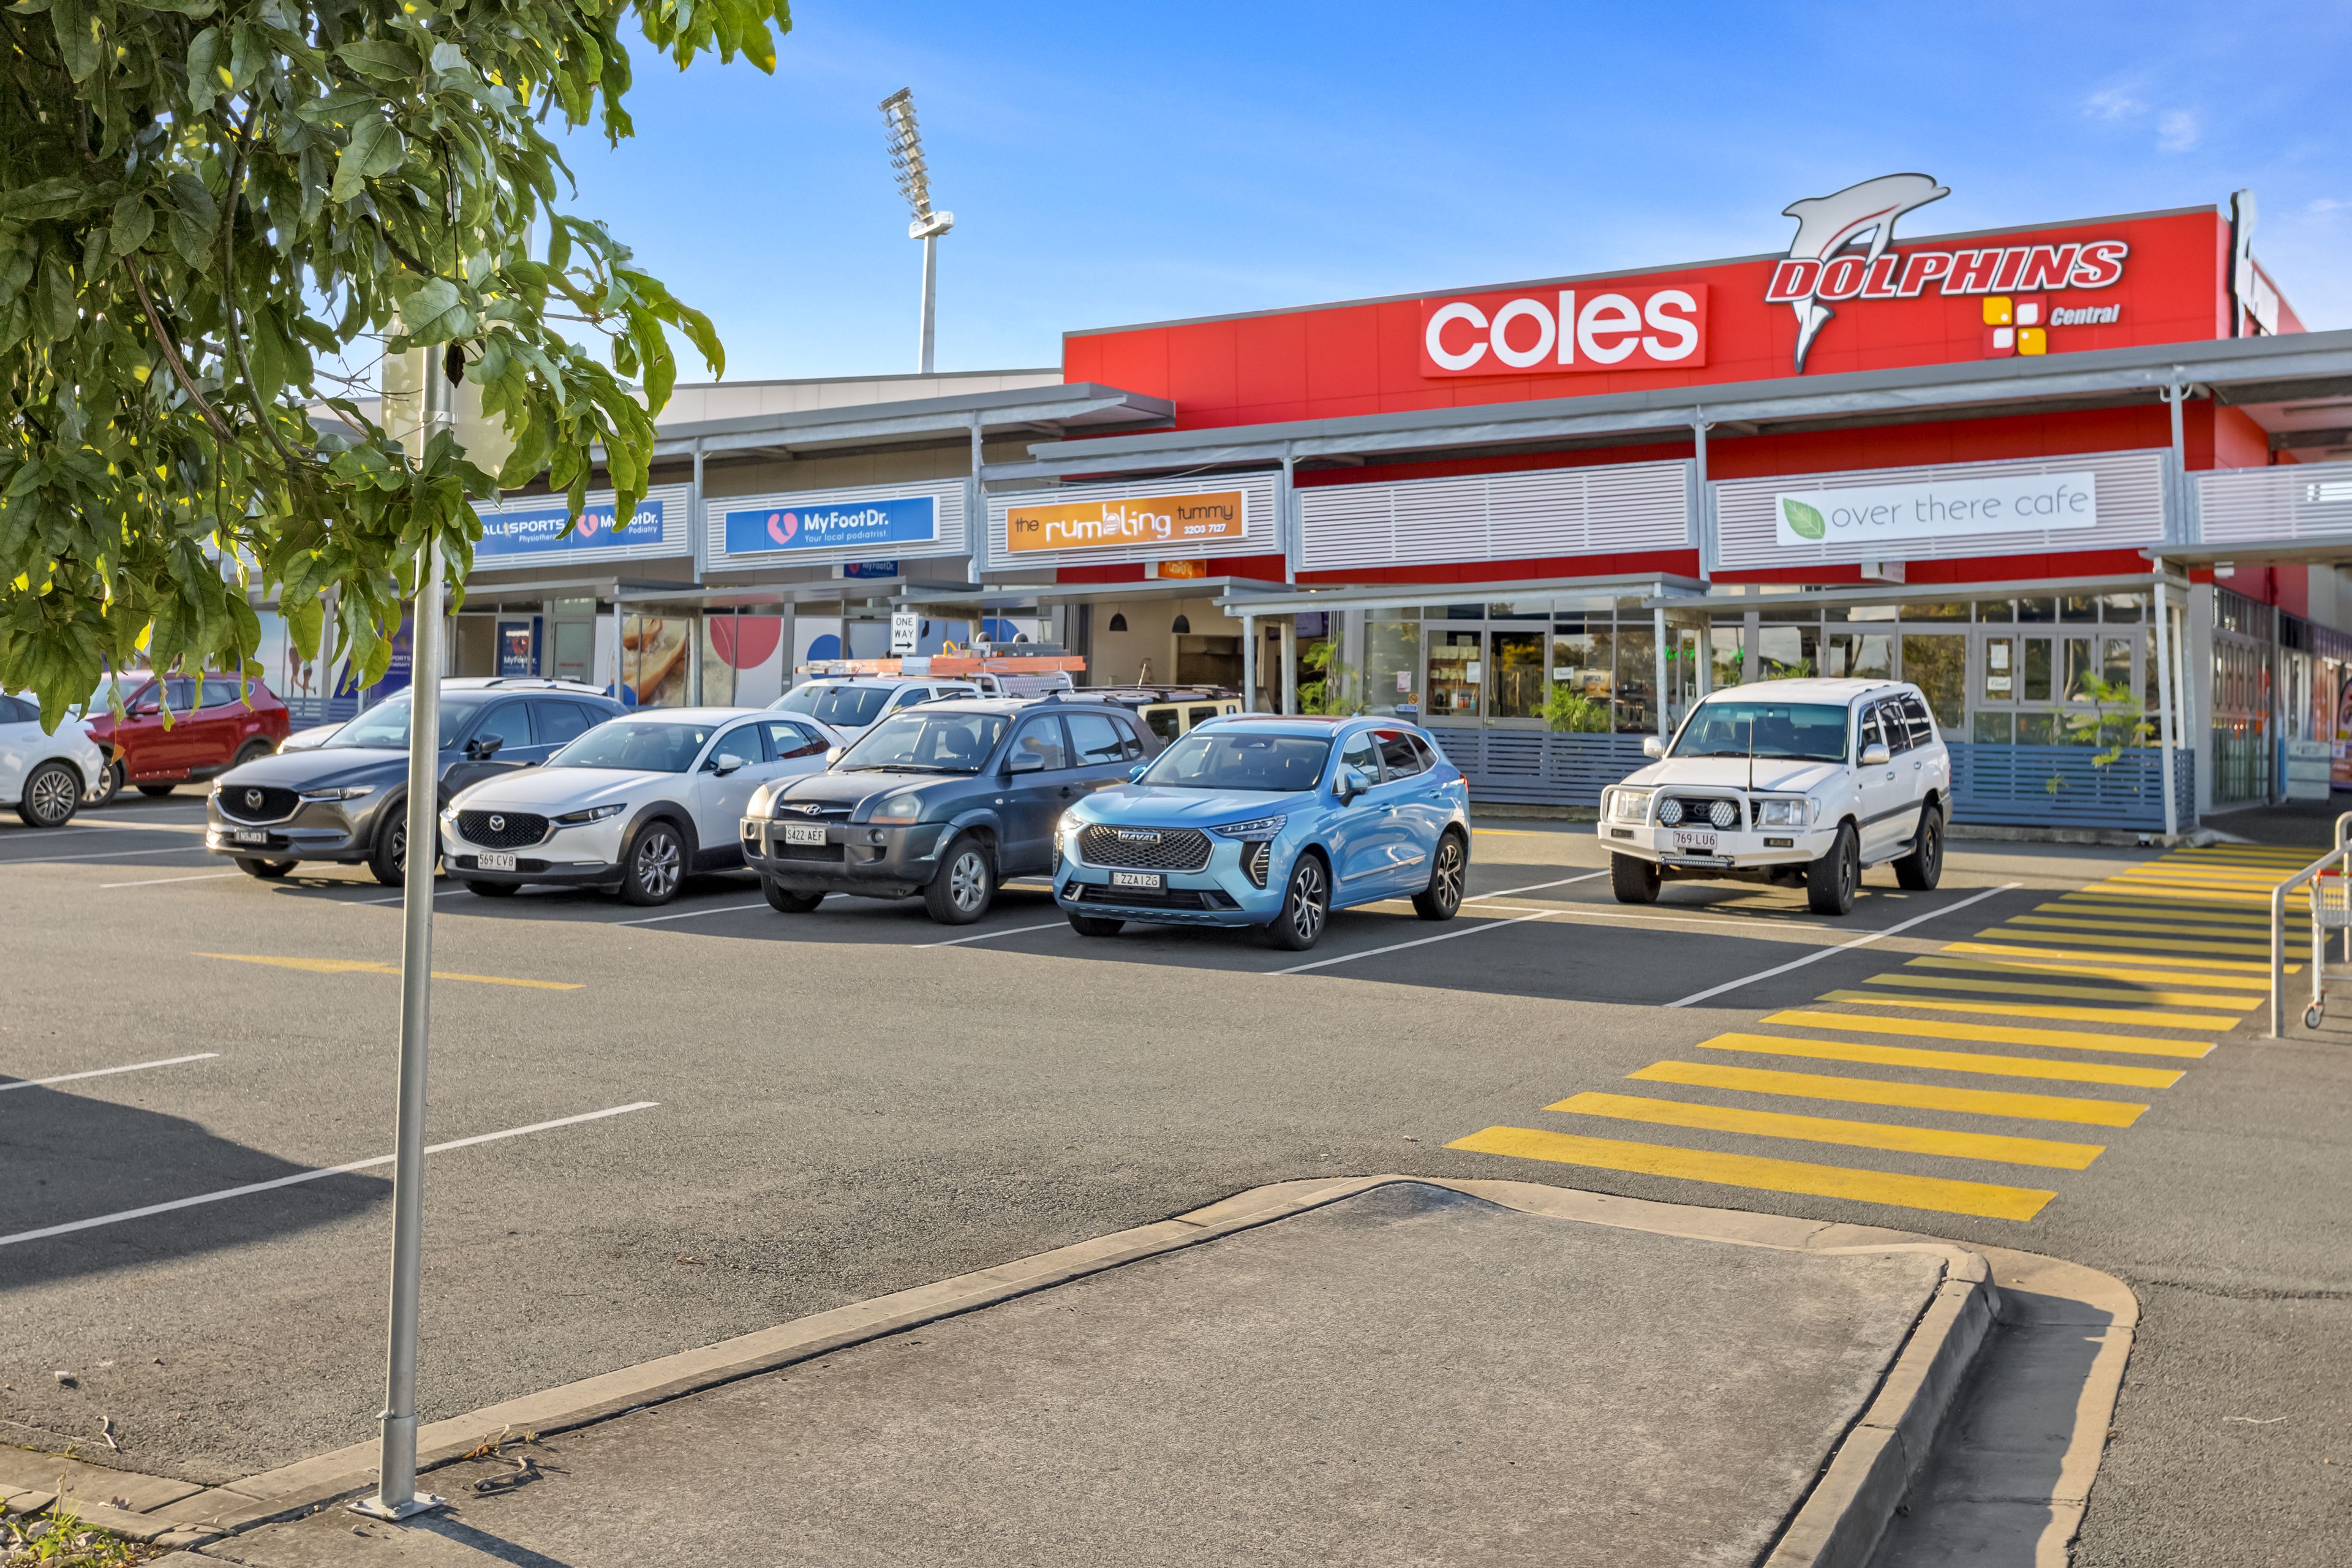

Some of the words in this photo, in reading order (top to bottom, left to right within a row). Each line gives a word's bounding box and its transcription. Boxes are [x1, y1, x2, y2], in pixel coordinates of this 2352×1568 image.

[1765, 240, 2128, 303] DOLPHINS
[2050, 304, 2120, 327] Central
[1425, 290, 1698, 371] coles
[1832, 503, 1901, 527] over
[1915, 494, 2001, 522] there
[2015, 484, 2089, 516] cafe
[600, 511, 658, 529] MyotDr.
[1015, 517, 1039, 532] the
[1045, 503, 1171, 542] rumbling
[1177, 504, 1234, 521] tummy
[628, 526, 657, 535] Podiatry
[1184, 526, 1206, 535] 3203
[1208, 524, 1226, 533] 7127
[519, 530, 564, 543] Physiothera
[805, 534, 823, 543] Your
[824, 532, 844, 541] local
[896, 617, 913, 626] ONE
[895, 629, 914, 638] WAY
[787, 829, 804, 840] S422
[808, 830, 823, 841] AEF
[1121, 833, 1156, 842] HAVAL
[1675, 833, 1692, 844] 769
[1695, 834, 1716, 845] LU6
[480, 854, 494, 865] 569
[497, 854, 514, 867] CV8
[1121, 874, 1158, 886] ZZA126
